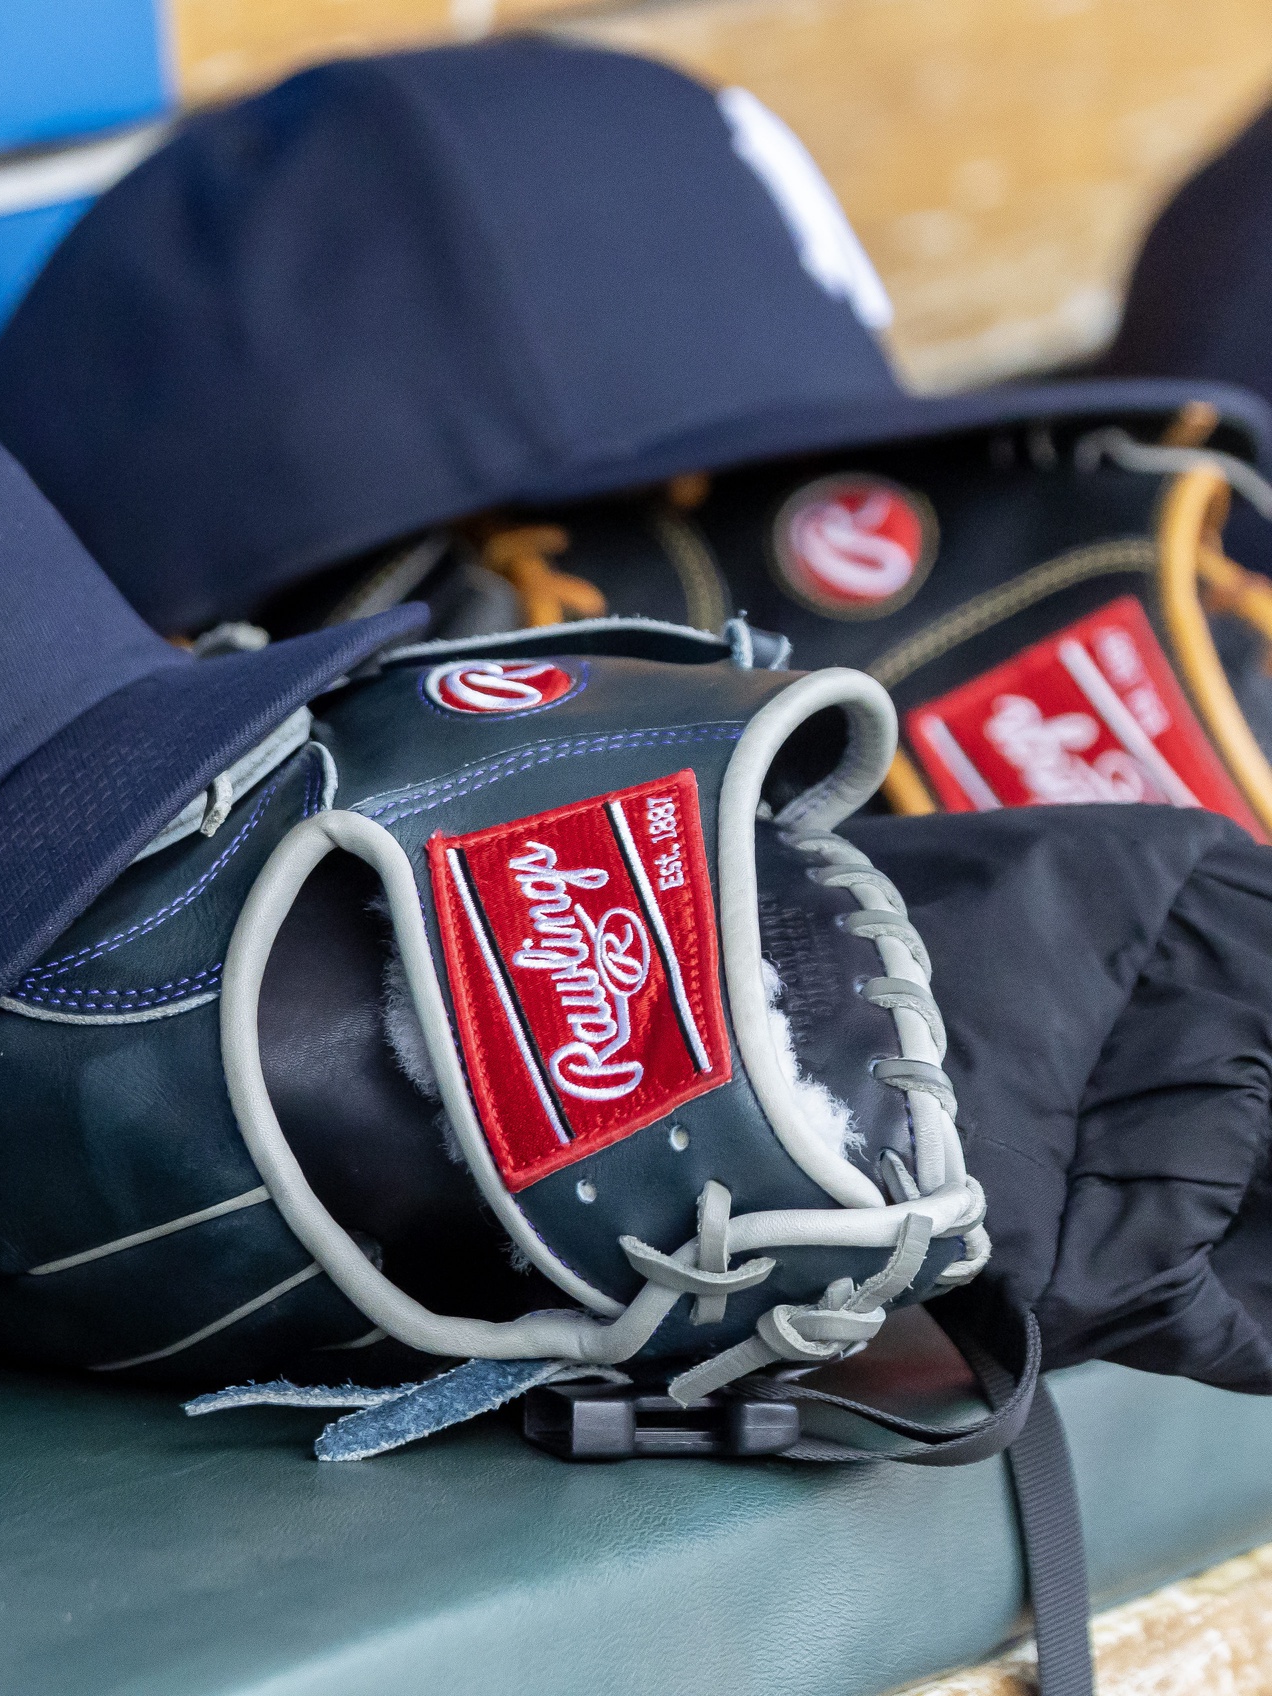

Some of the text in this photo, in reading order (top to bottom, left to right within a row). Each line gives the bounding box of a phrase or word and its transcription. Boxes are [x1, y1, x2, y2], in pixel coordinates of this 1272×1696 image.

[647, 797, 685, 891] Est. 1887
[510, 841, 645, 1101] Rawlings
